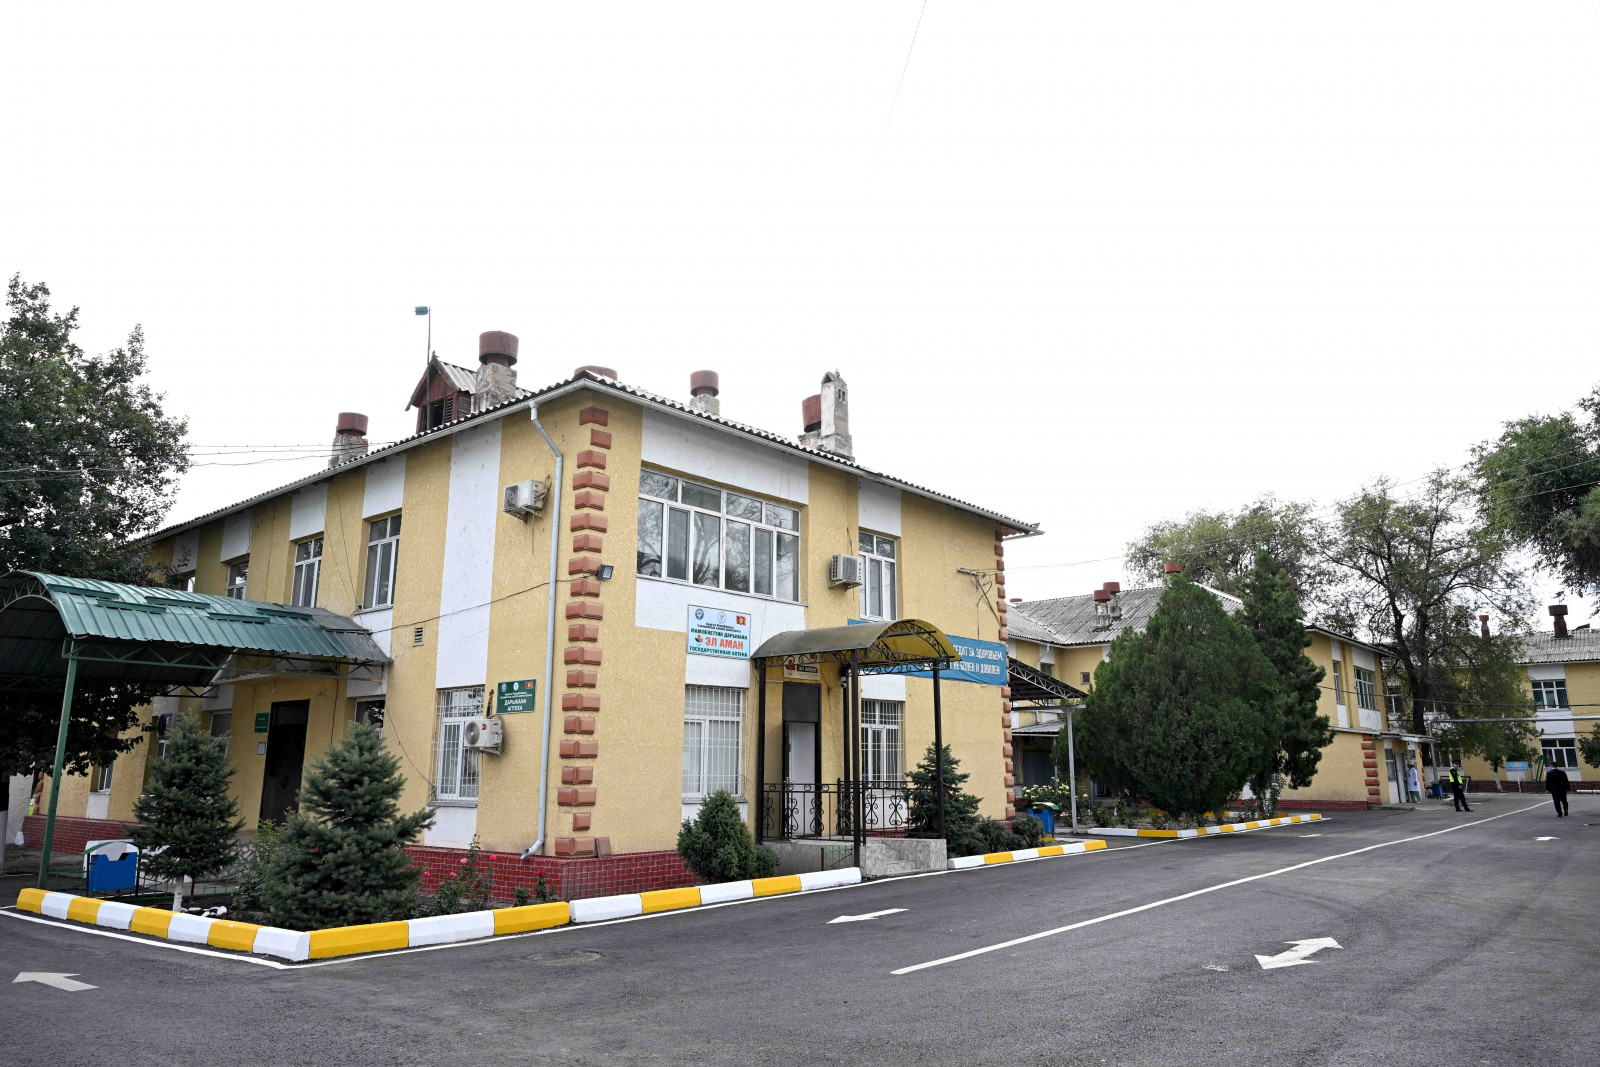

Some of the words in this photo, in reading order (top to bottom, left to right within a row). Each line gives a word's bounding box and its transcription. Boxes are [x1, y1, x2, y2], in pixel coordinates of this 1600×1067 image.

[706, 637, 717, 646] ЭЛ
[720, 638, 743, 650] АМАН
[969, 647, 975, 657] ЗА
